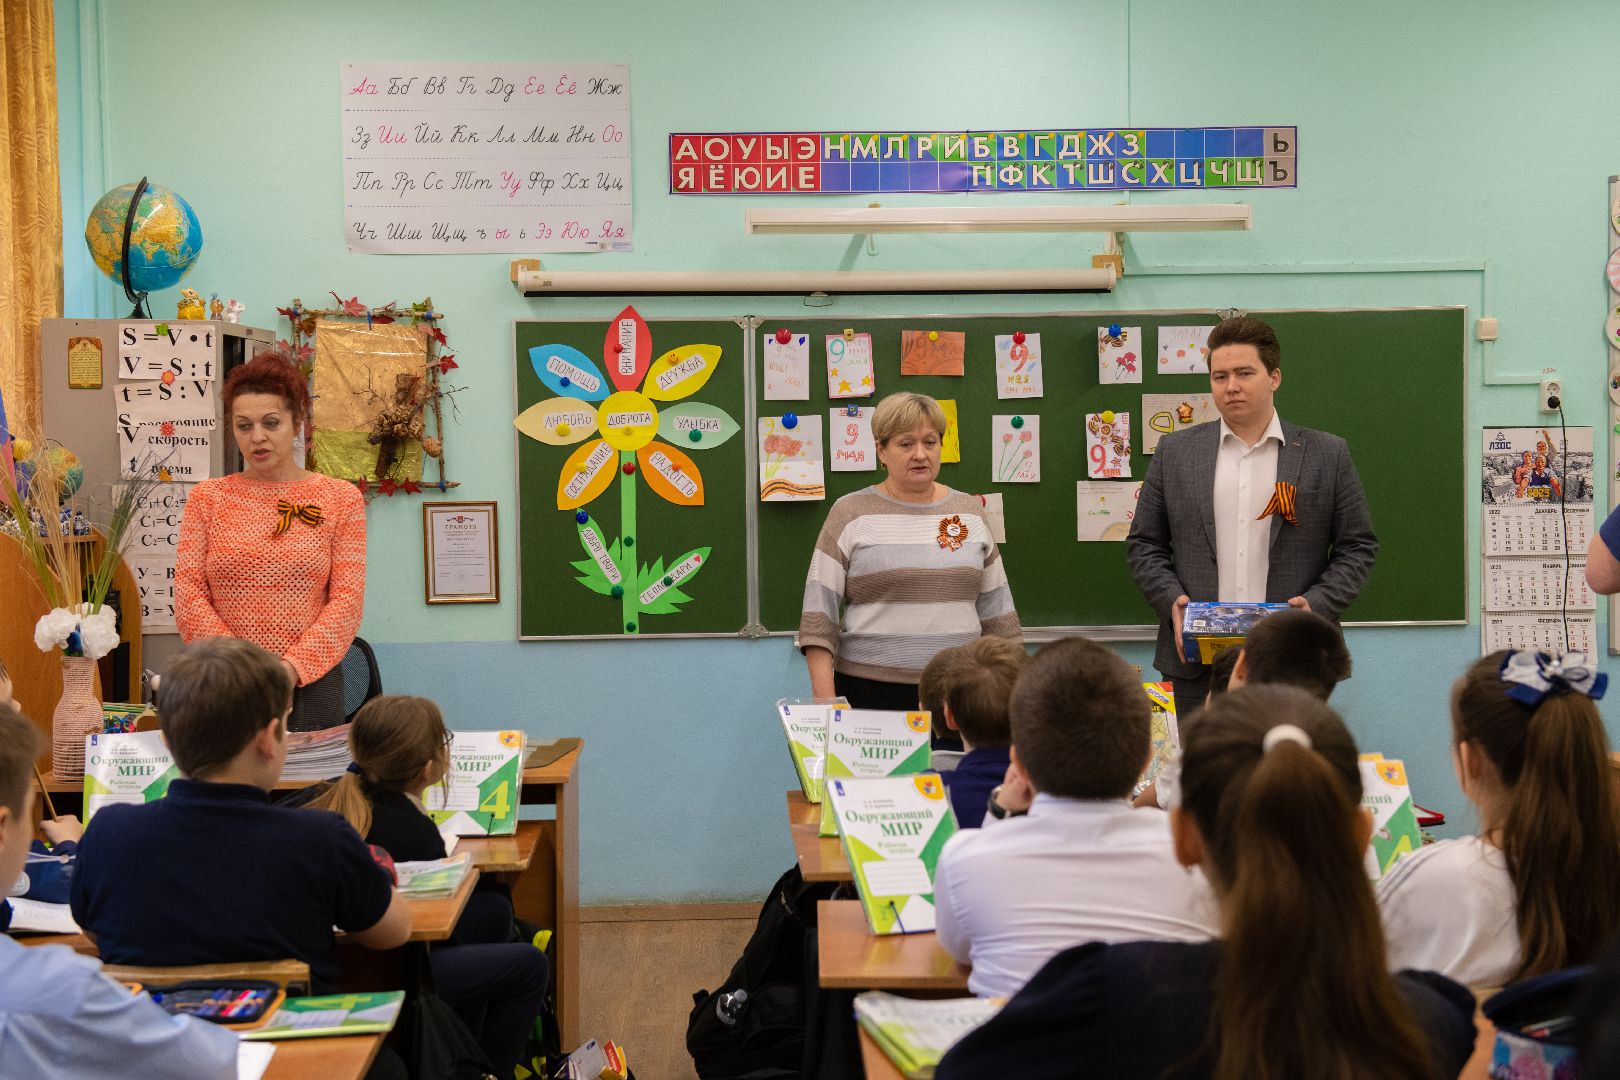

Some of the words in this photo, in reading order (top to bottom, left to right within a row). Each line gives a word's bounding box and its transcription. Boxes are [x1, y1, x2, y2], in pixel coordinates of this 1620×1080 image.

[350, 77, 378, 94] Аа
[388, 77, 418, 94] Бб
[424, 76, 446, 94] Вв
[457, 76, 476, 94] Гг
[486, 77, 514, 102] Дд
[524, 76, 545, 94] Ее
[556, 74, 576, 94] Ёё
[588, 78, 621, 94] Жж
[352, 126, 371, 149] Зз
[378, 125, 406, 143] Ии
[415, 123, 443, 143] Йй
[451, 125, 479, 142] Кк
[487, 125, 515, 142] Лл
[523, 125, 559, 142] Мм
[567, 125, 595, 142] Нн
[602, 125, 622, 142] Оо
[353, 171, 383, 189] Пп
[392, 172, 415, 198] Рр
[423, 172, 443, 189] Сс
[452, 171, 492, 189] Тт
[501, 172, 521, 197] Уу
[529, 171, 554, 195] Фф
[561, 172, 589, 189] Хх
[597, 172, 623, 191] Цц
[353, 223, 376, 240] Чч
[387, 223, 422, 239] Шш
[432, 223, 467, 242] Щщ
[535, 223, 552, 239] Ээ
[561, 221, 589, 239] Юю
[598, 221, 625, 238] Яя
[124, 328, 136, 345] S
[205, 332, 212, 347] t
[621, 321, 633, 374] ВНИМАНИЕ
[829, 338, 845, 363] 9
[1010, 342, 1029, 373] 9
[124, 357, 142, 374] V
[171, 358, 182, 376] S
[204, 361, 212, 376] t
[550, 358, 597, 391] ПОМОЩЬ
[660, 355, 703, 390] ДРУЖБА
[122, 387, 131, 402] t
[159, 383, 171, 400] S
[608, 414, 650, 426] ДОБРОТА
[677, 417, 718, 429] УЛЫБКА
[148, 436, 208, 448] скорость
[844, 423, 859, 446] 9
[1489, 442, 1511, 450] ЛЗОС
[565, 442, 612, 498] СОСТРАДАНИЕ
[1090, 444, 1108, 475] 9
[651, 453, 694, 496] РАДОСТЬ
[600, 554, 620, 580] ТВОРИ
[834, 733, 912, 747] Окружающий
[91, 755, 169, 766] Окружающий
[861, 747, 899, 759] МИР
[117, 765, 155, 776] МИР
[456, 762, 491, 771] МИР
[480, 780, 510, 819] 4
[845, 809, 933, 824] Окружающий
[881, 822, 922, 836] МИР
